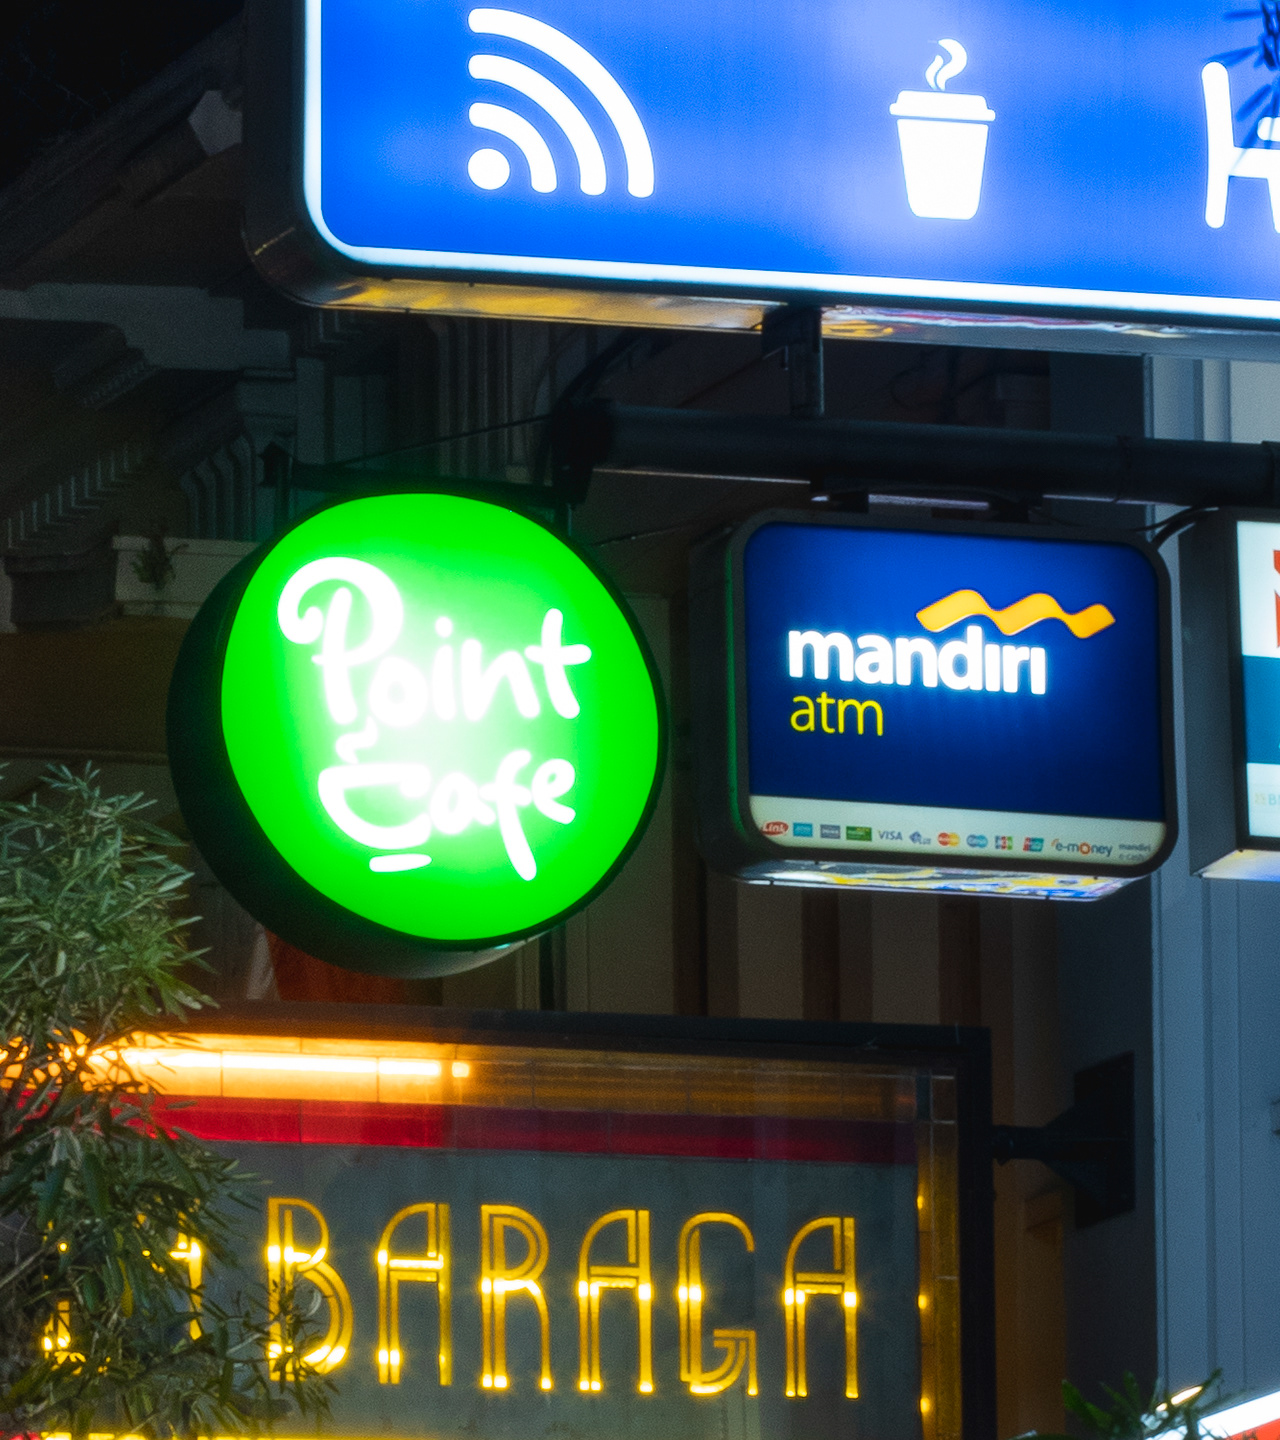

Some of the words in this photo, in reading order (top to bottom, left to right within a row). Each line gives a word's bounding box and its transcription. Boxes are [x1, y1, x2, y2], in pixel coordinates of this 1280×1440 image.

[277, 556, 593, 727] Point
[788, 623, 1047, 696] mandiri
[789, 691, 884, 737] atm
[317, 750, 577, 881] Cafe
[878, 830, 903, 842] VISA
[267, 1197, 859, 1399] BARAGA
